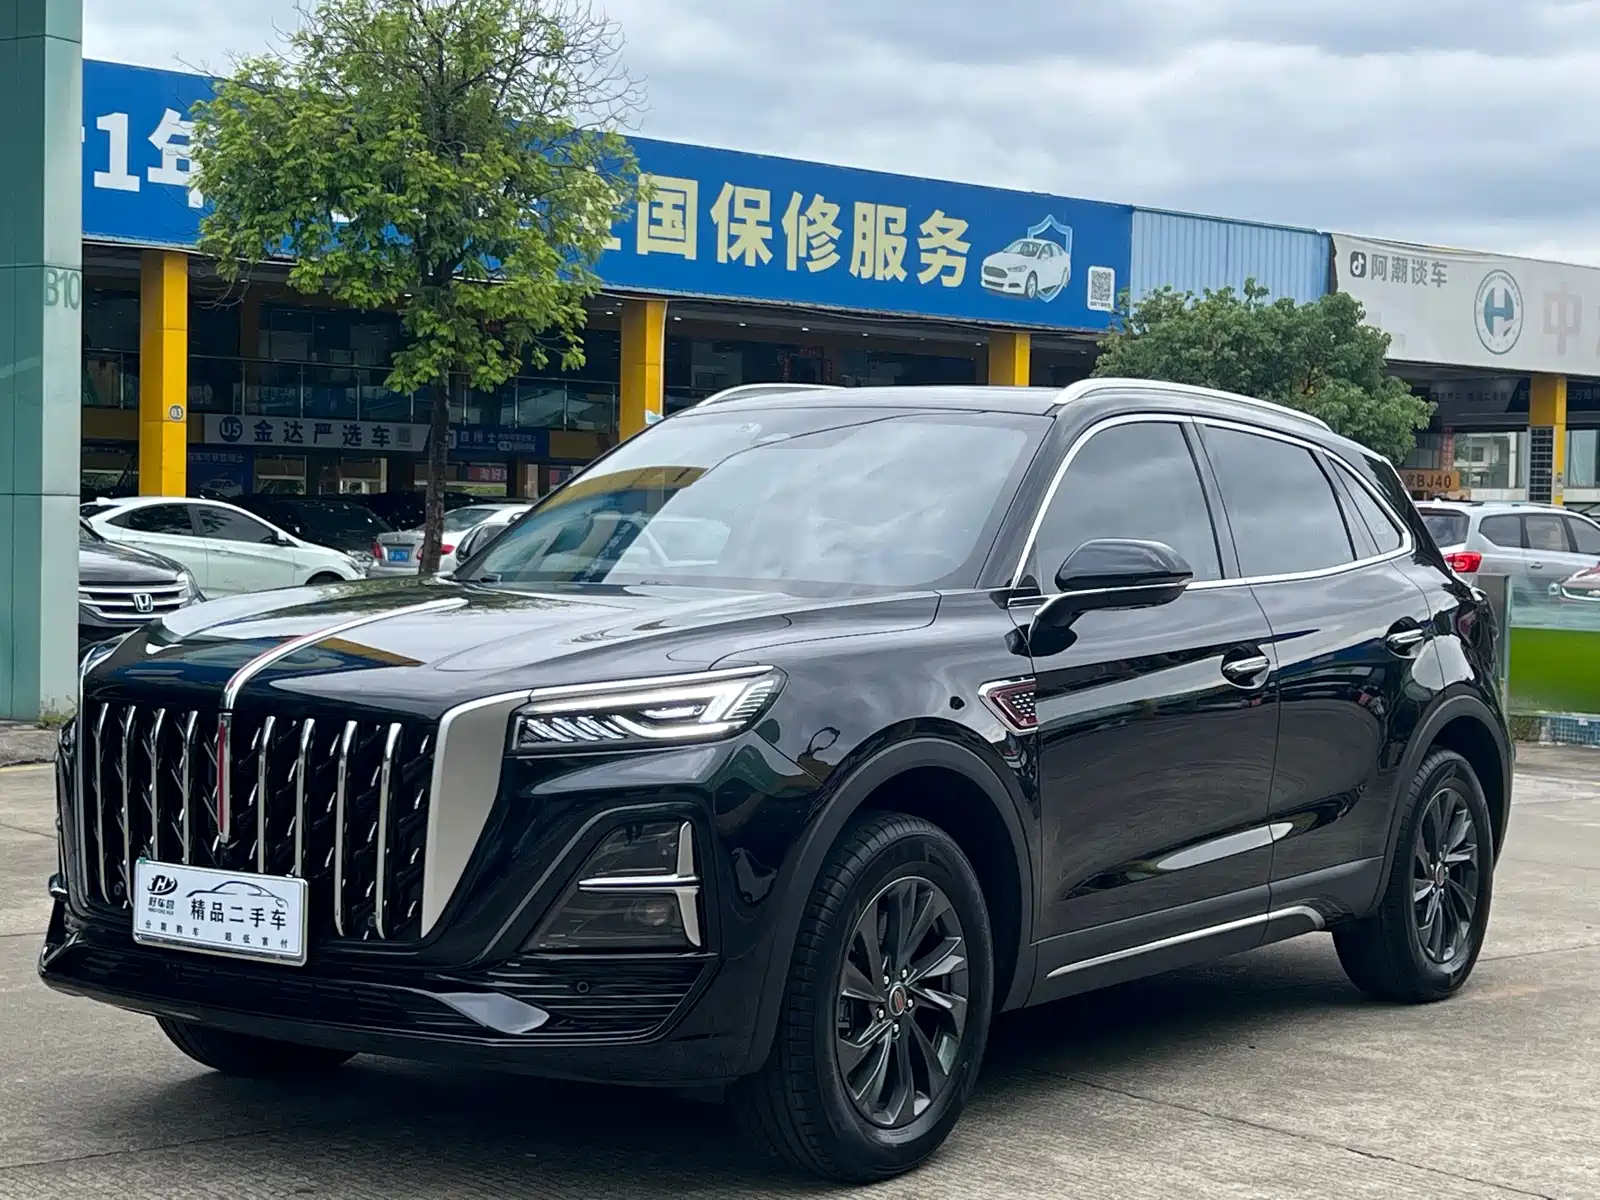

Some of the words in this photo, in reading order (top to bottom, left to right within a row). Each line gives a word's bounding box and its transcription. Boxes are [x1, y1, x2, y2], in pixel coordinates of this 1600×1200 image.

[1370, 253, 1448, 288] 阿潮谈车
[43, 269, 81, 310] B10
[253, 419, 391, 447] 金达严选车
[190, 898, 287, 931] 精品二手车
